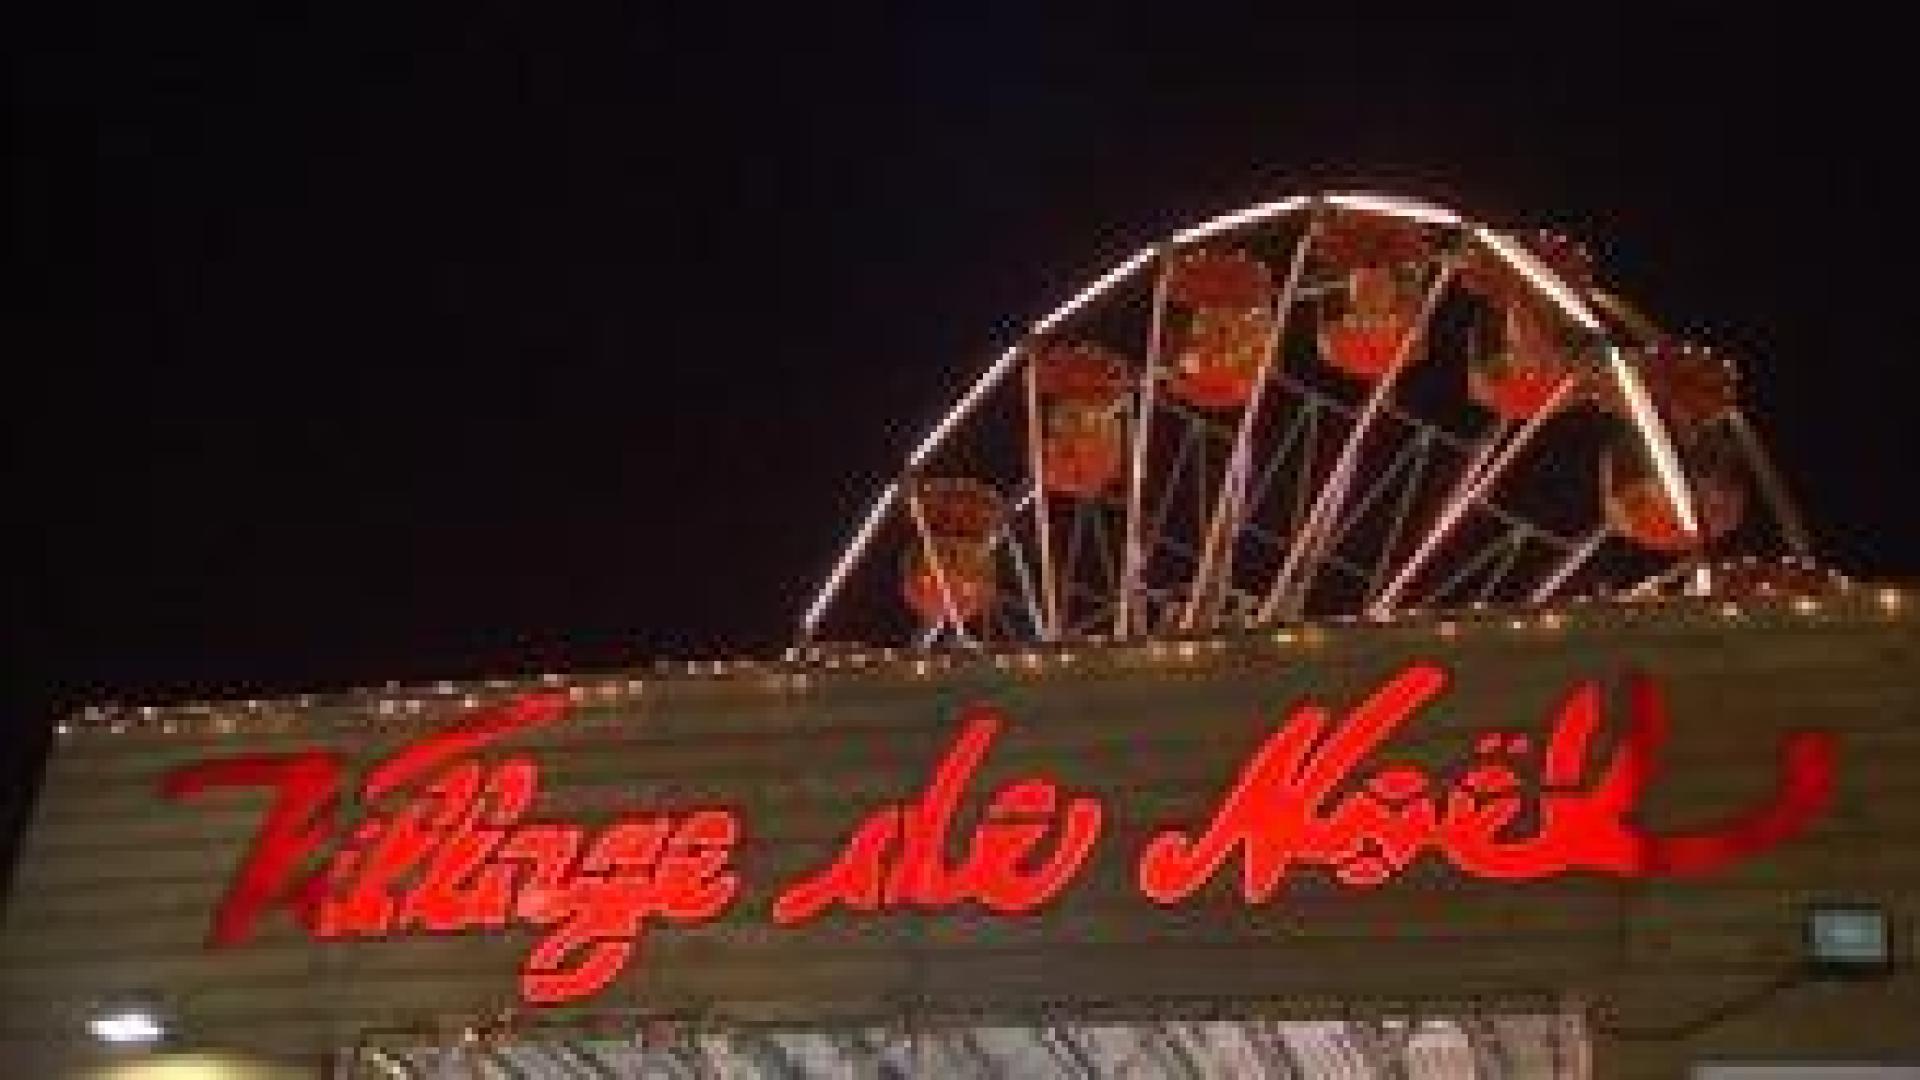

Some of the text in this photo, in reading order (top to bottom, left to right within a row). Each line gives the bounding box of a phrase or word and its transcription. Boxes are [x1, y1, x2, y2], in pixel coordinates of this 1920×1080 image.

[162, 661, 1840, 1006] Village de Noël
